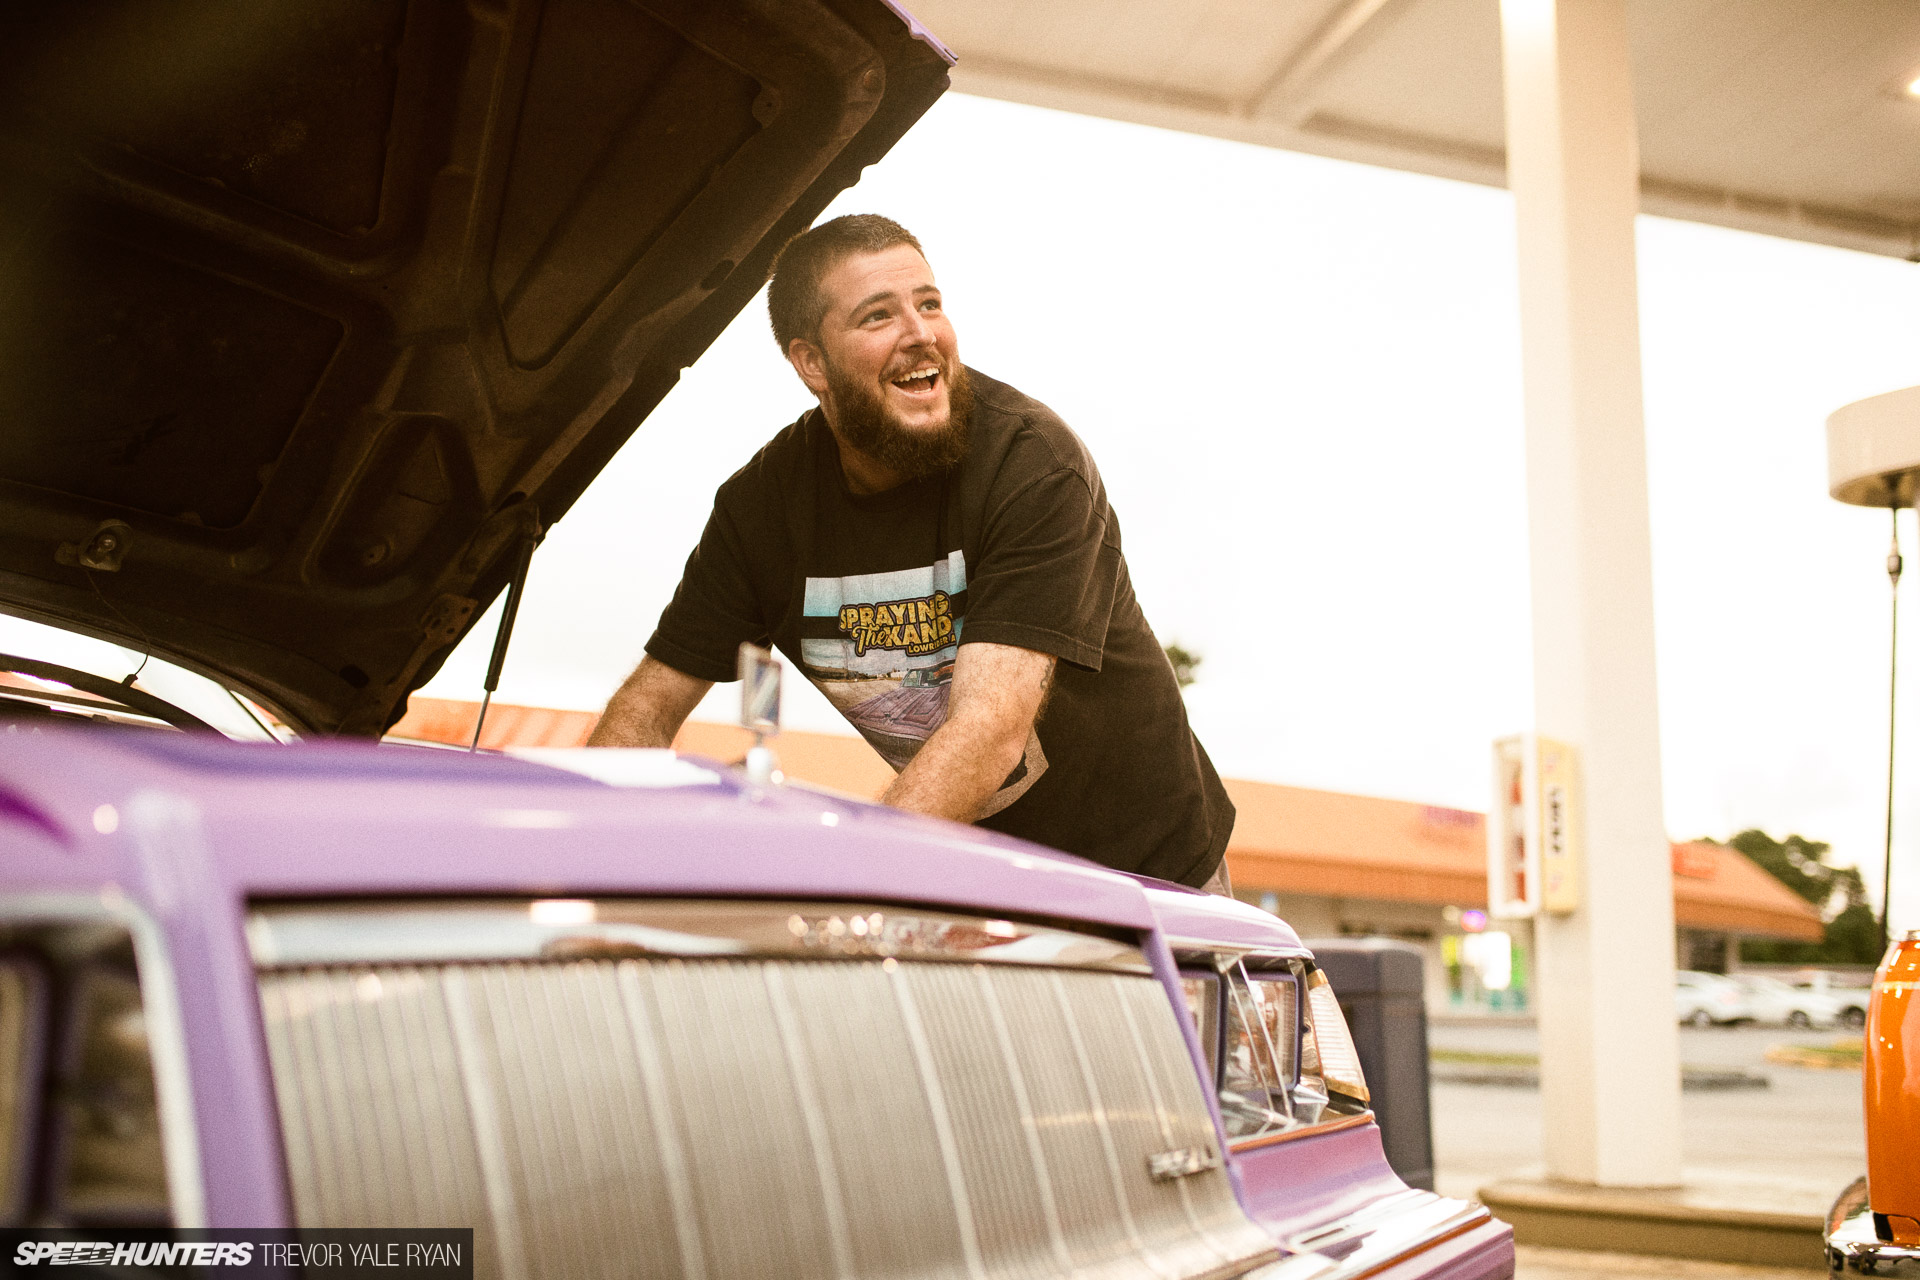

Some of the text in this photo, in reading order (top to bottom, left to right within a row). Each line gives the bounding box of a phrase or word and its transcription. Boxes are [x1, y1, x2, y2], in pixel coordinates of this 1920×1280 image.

[840, 594, 949, 630] SPRAYING
[852, 613, 953, 653] The KAND
[908, 636, 949, 653] LOWRIDER
